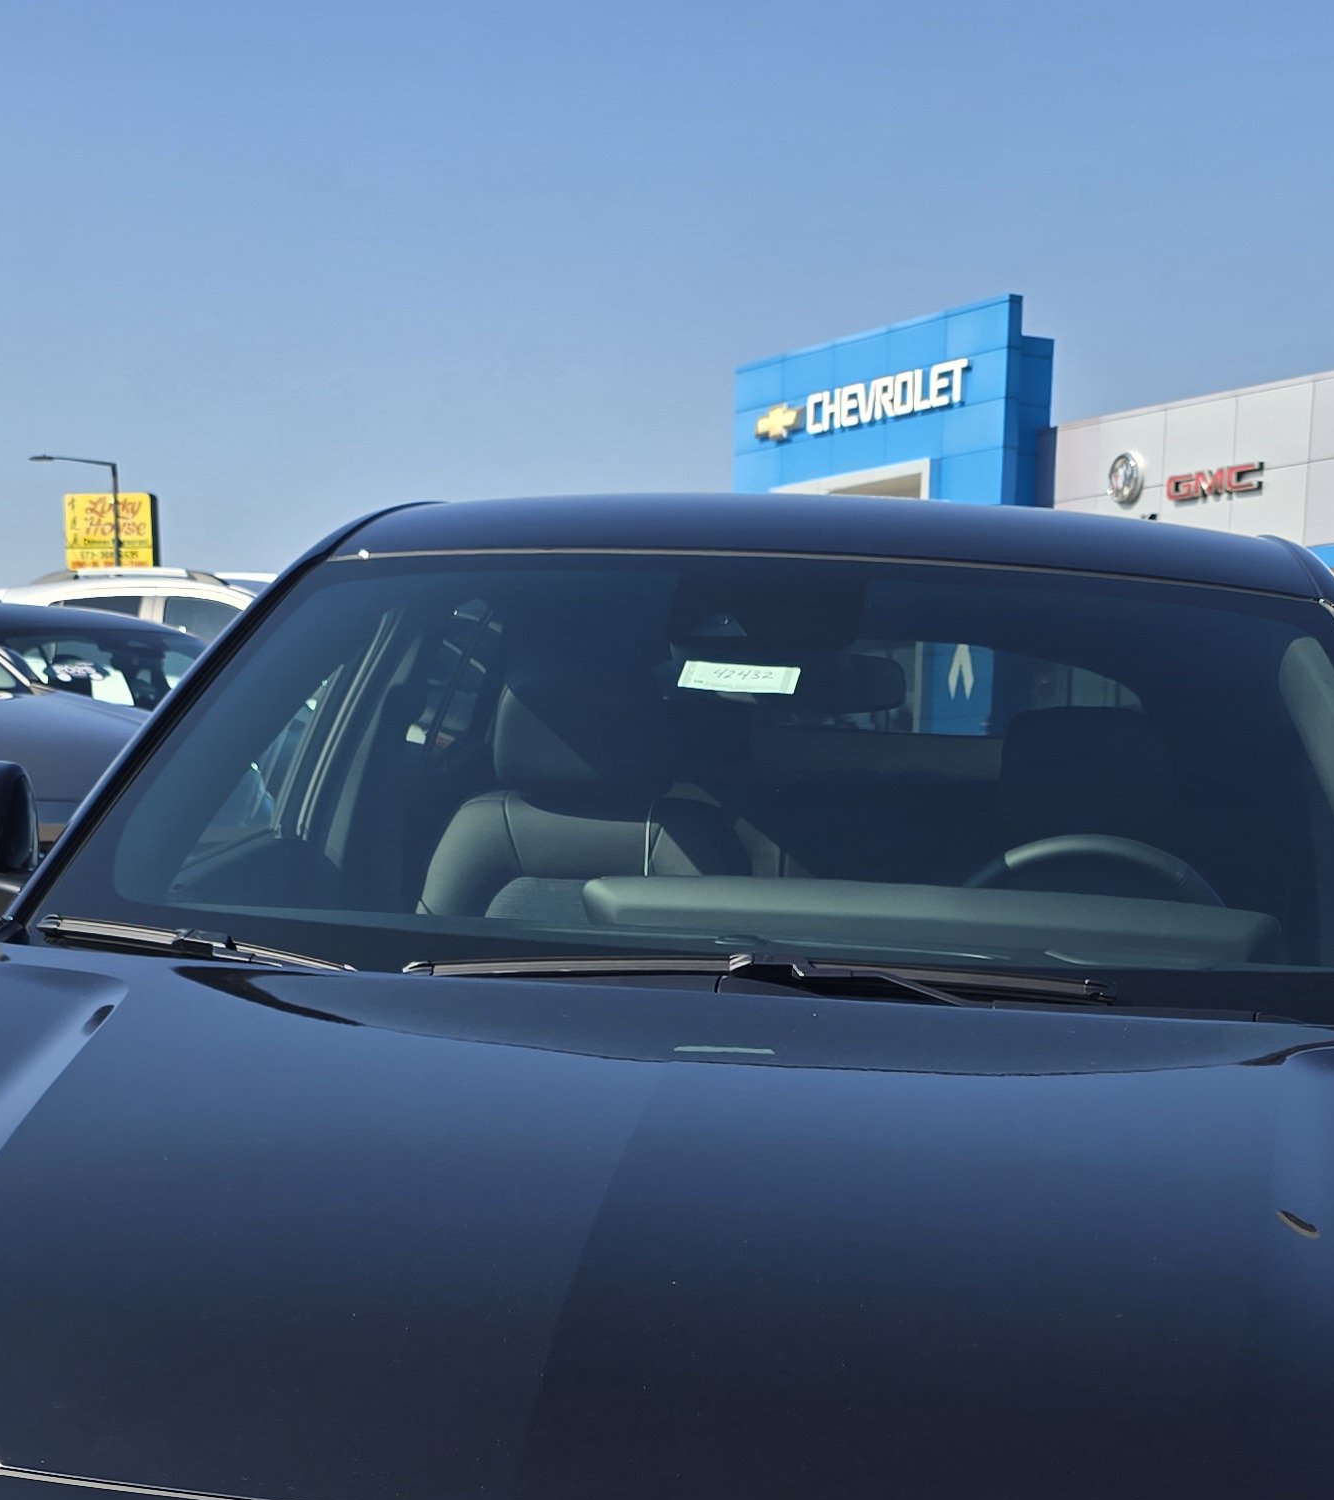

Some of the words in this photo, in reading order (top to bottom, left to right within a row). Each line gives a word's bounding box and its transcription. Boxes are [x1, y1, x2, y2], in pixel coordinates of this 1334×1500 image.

[806, 358, 969, 435] CHEVROLET
[1166, 462, 1264, 501] GMC
[84, 496, 143, 518] Luky
[83, 515, 147, 537] Hose
[713, 667, 774, 681] 42432
